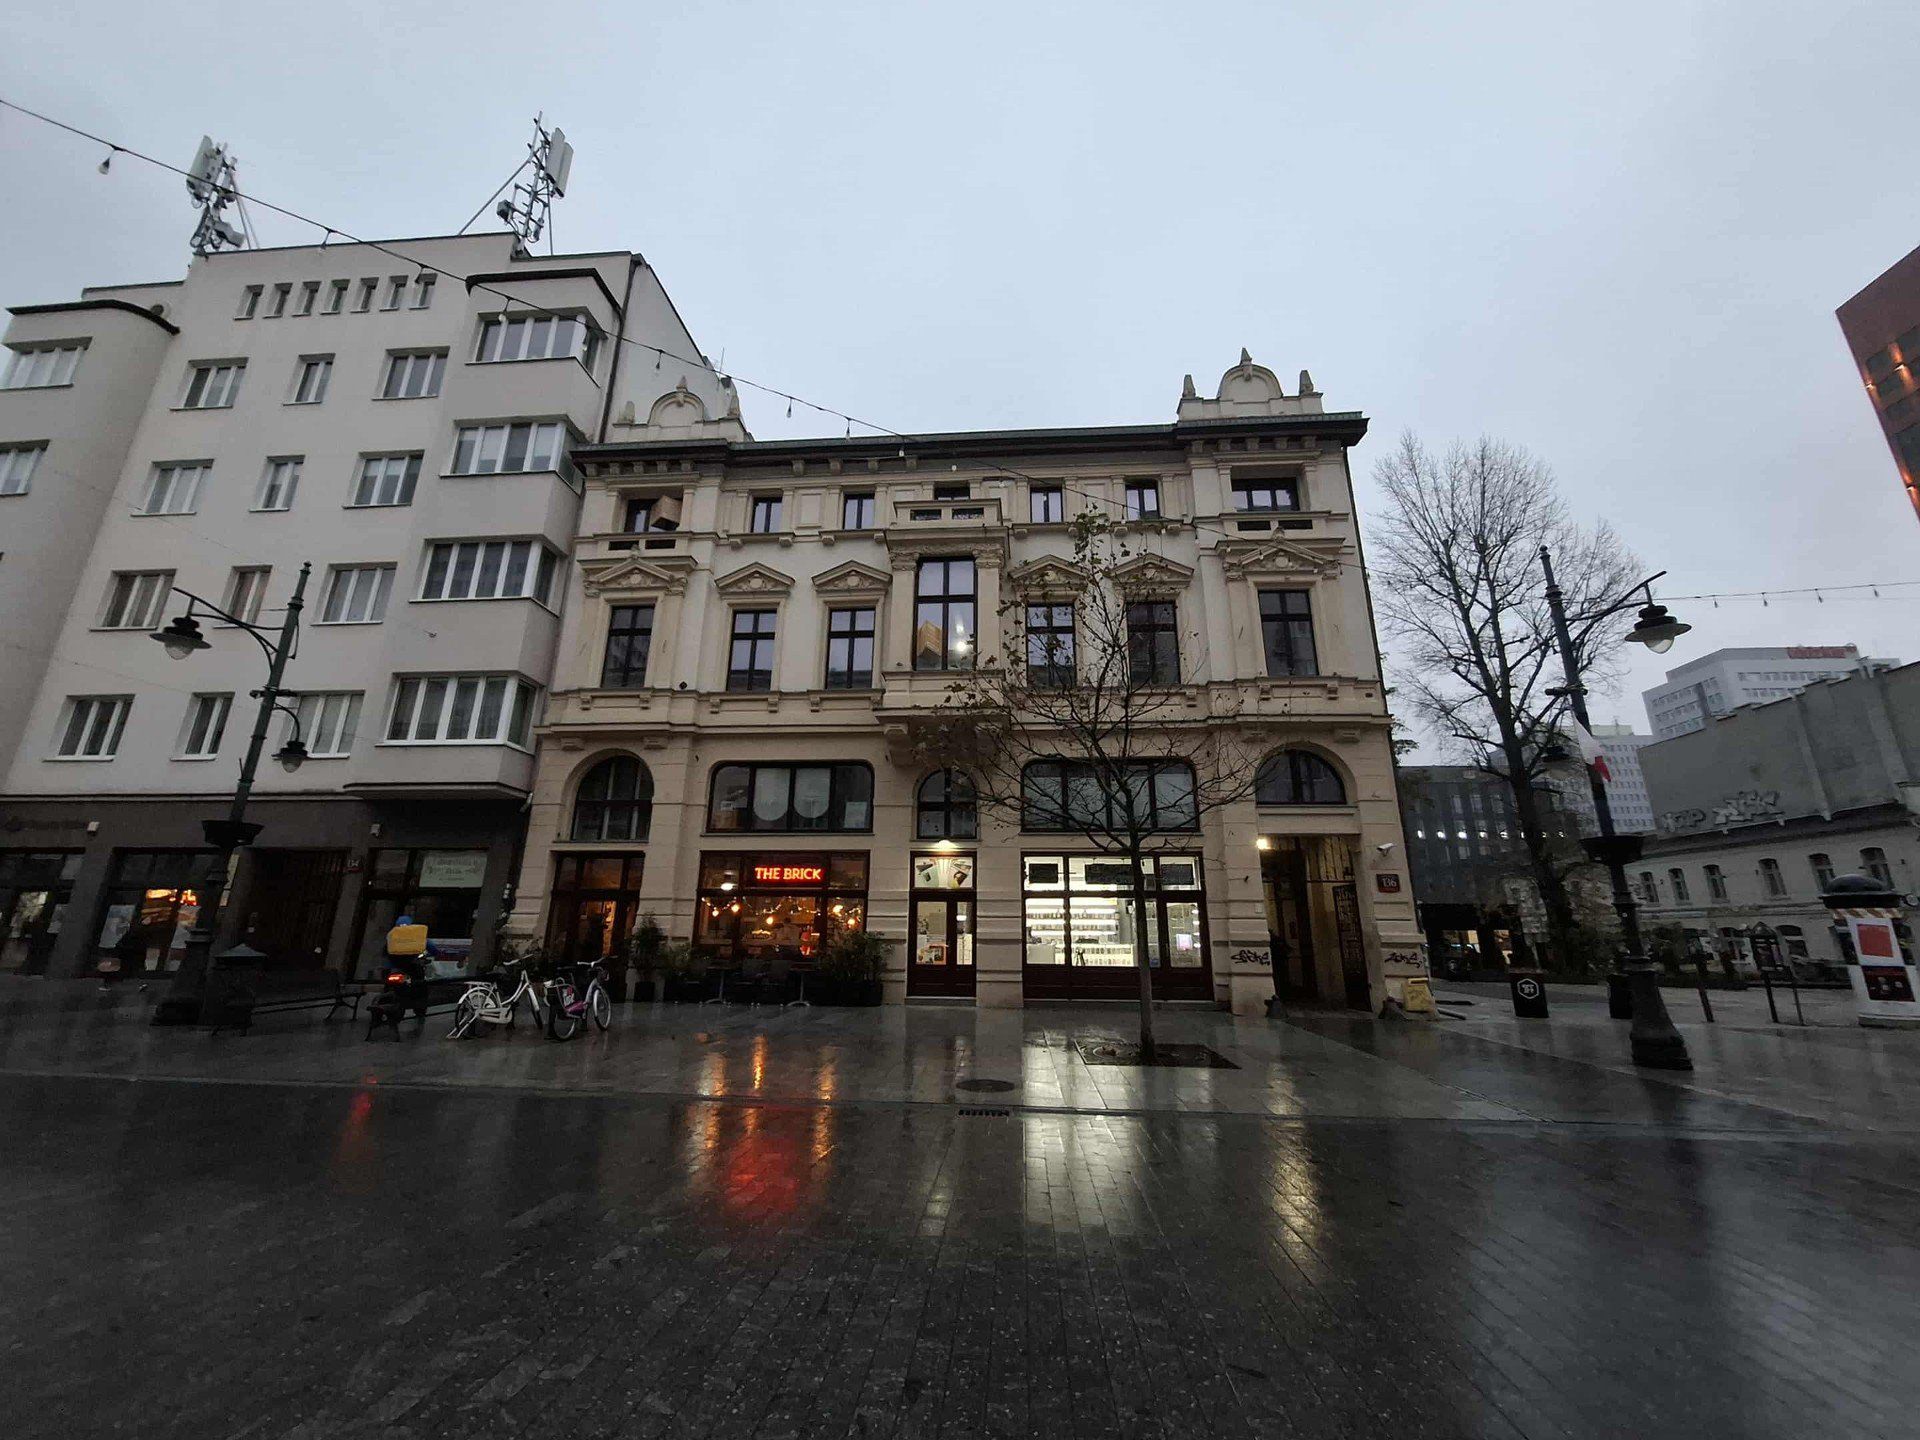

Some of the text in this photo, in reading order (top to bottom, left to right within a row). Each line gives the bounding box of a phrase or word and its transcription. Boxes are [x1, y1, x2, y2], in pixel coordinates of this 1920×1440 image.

[755, 867, 821, 880] THE BRICK
[1382, 878, 1397, 887] 136
